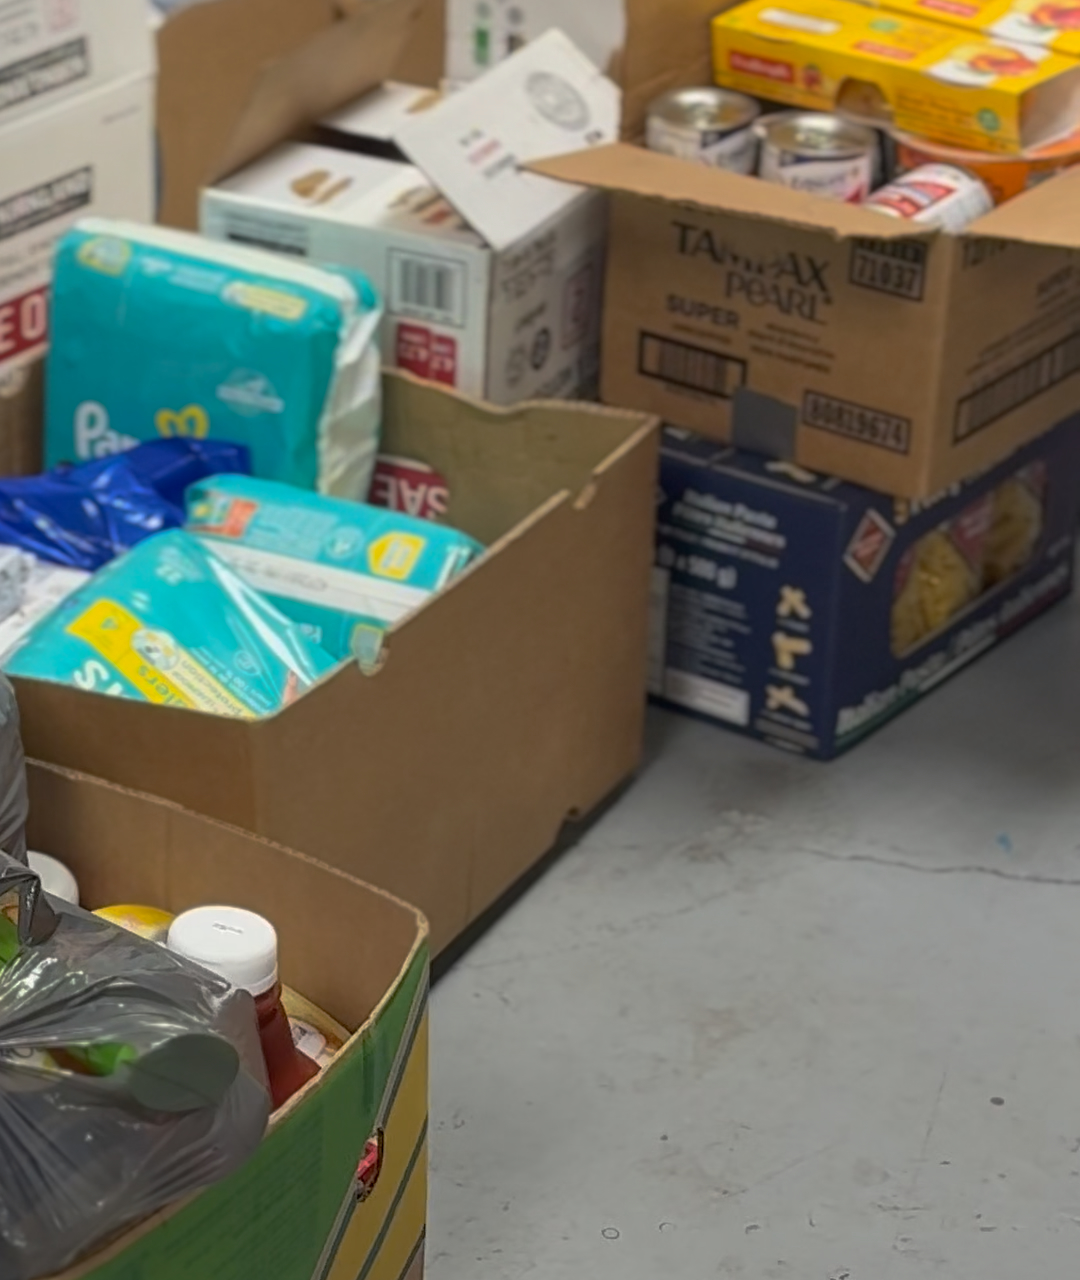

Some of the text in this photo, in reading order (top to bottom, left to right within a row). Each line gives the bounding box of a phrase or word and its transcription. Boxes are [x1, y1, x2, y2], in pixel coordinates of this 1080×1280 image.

[672, 219, 833, 293] TAAX
[21, 293, 48, 341] 0
[666, 293, 740, 329] SUPER
